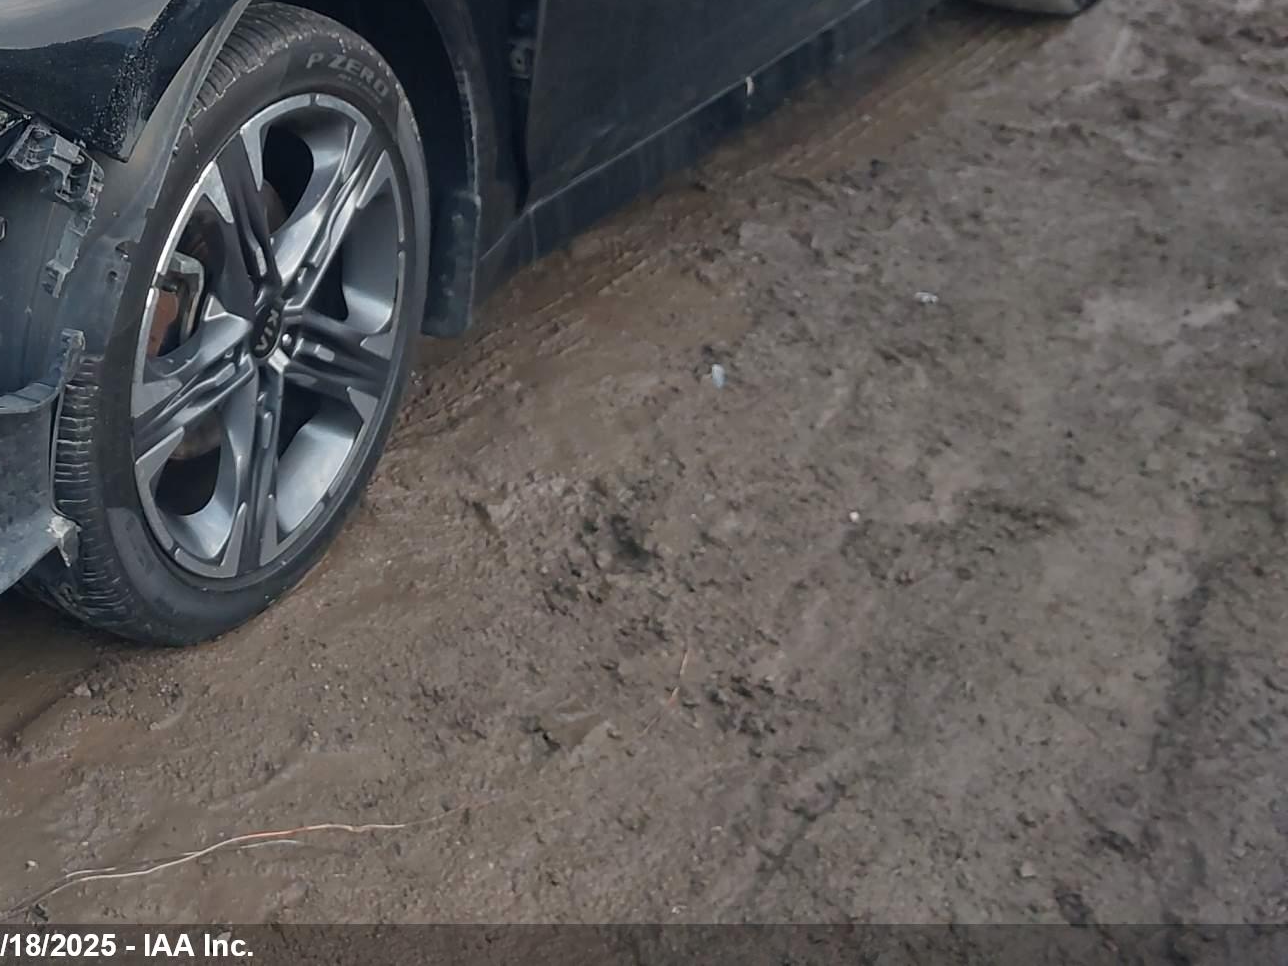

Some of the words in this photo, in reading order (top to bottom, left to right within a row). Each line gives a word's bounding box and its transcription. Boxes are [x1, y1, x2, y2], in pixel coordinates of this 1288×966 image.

[306, 52, 324, 69] P
[328, 54, 389, 97] ZERO
[255, 308, 280, 351] KIA
